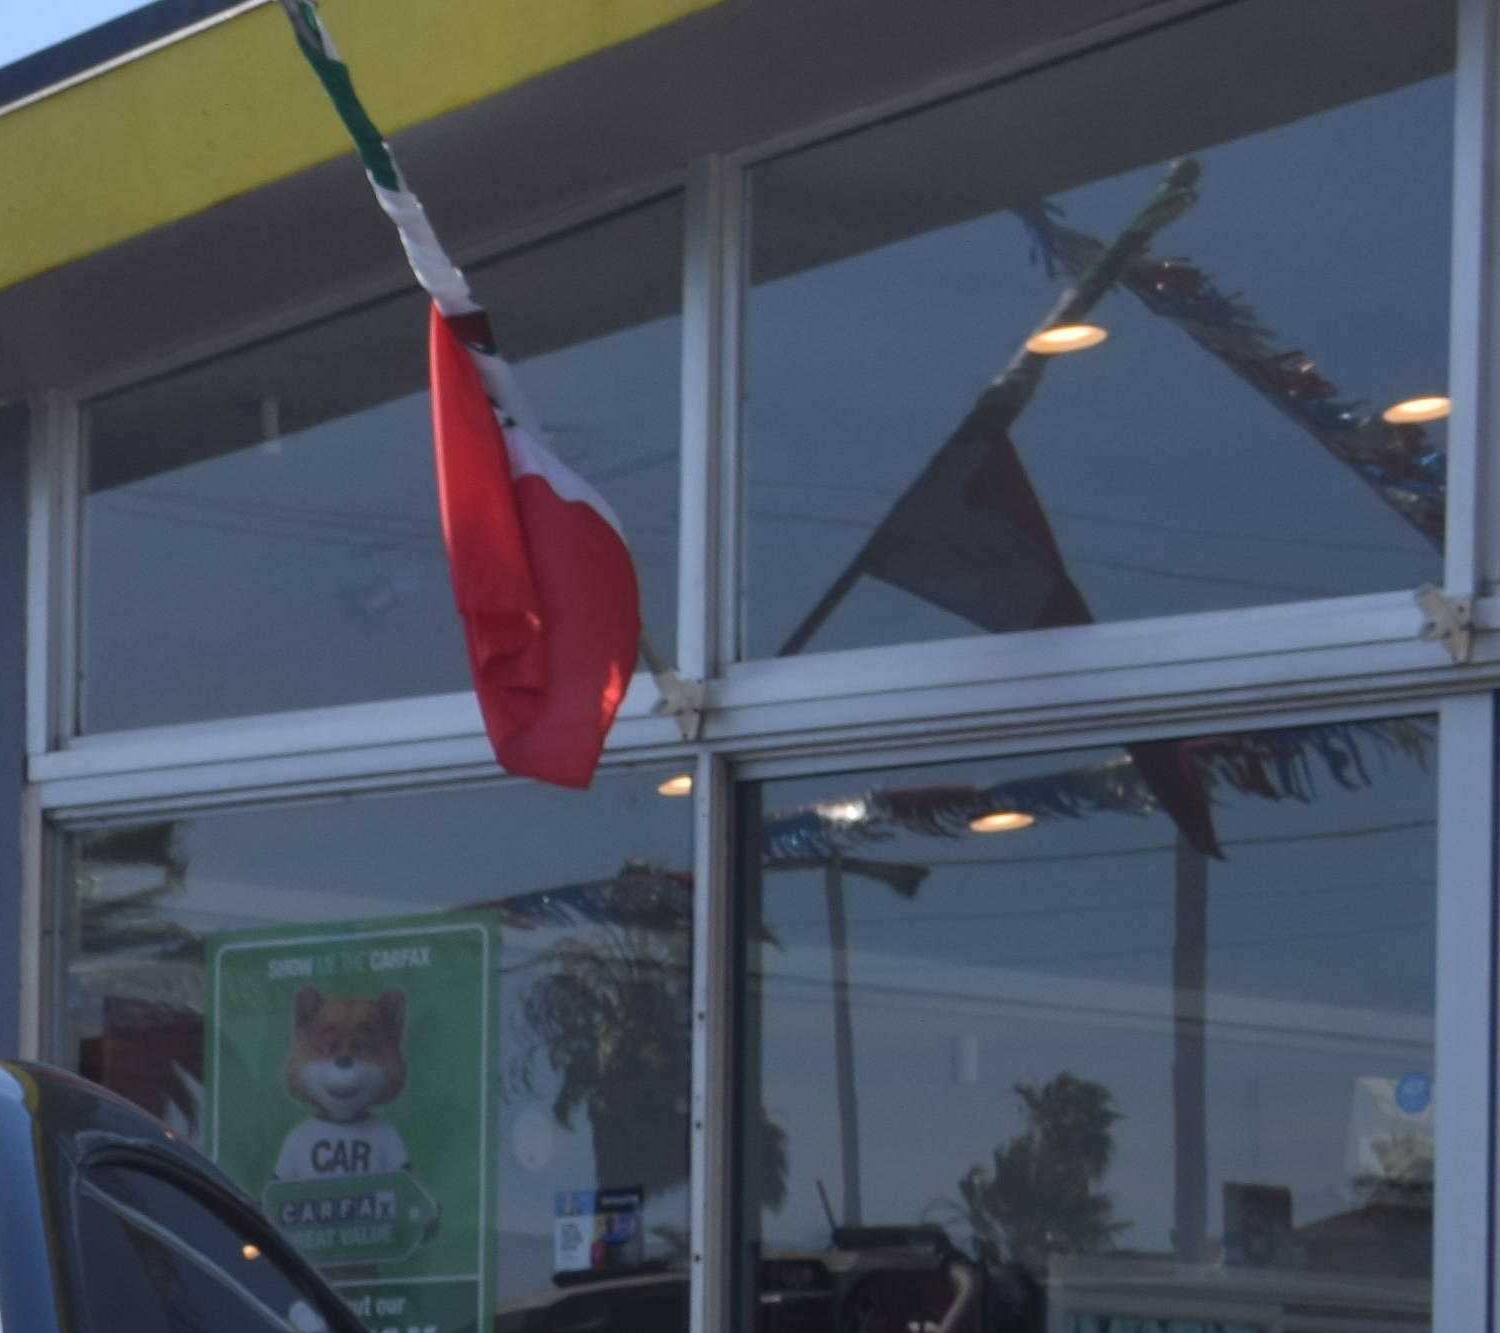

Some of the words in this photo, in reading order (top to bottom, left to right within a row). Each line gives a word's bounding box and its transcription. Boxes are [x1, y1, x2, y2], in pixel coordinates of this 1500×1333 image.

[268, 957, 313, 980] SHOW
[369, 946, 432, 971] CARFAX
[311, 1137, 373, 1173] CAR
[281, 1189, 396, 1224] CARFAX
